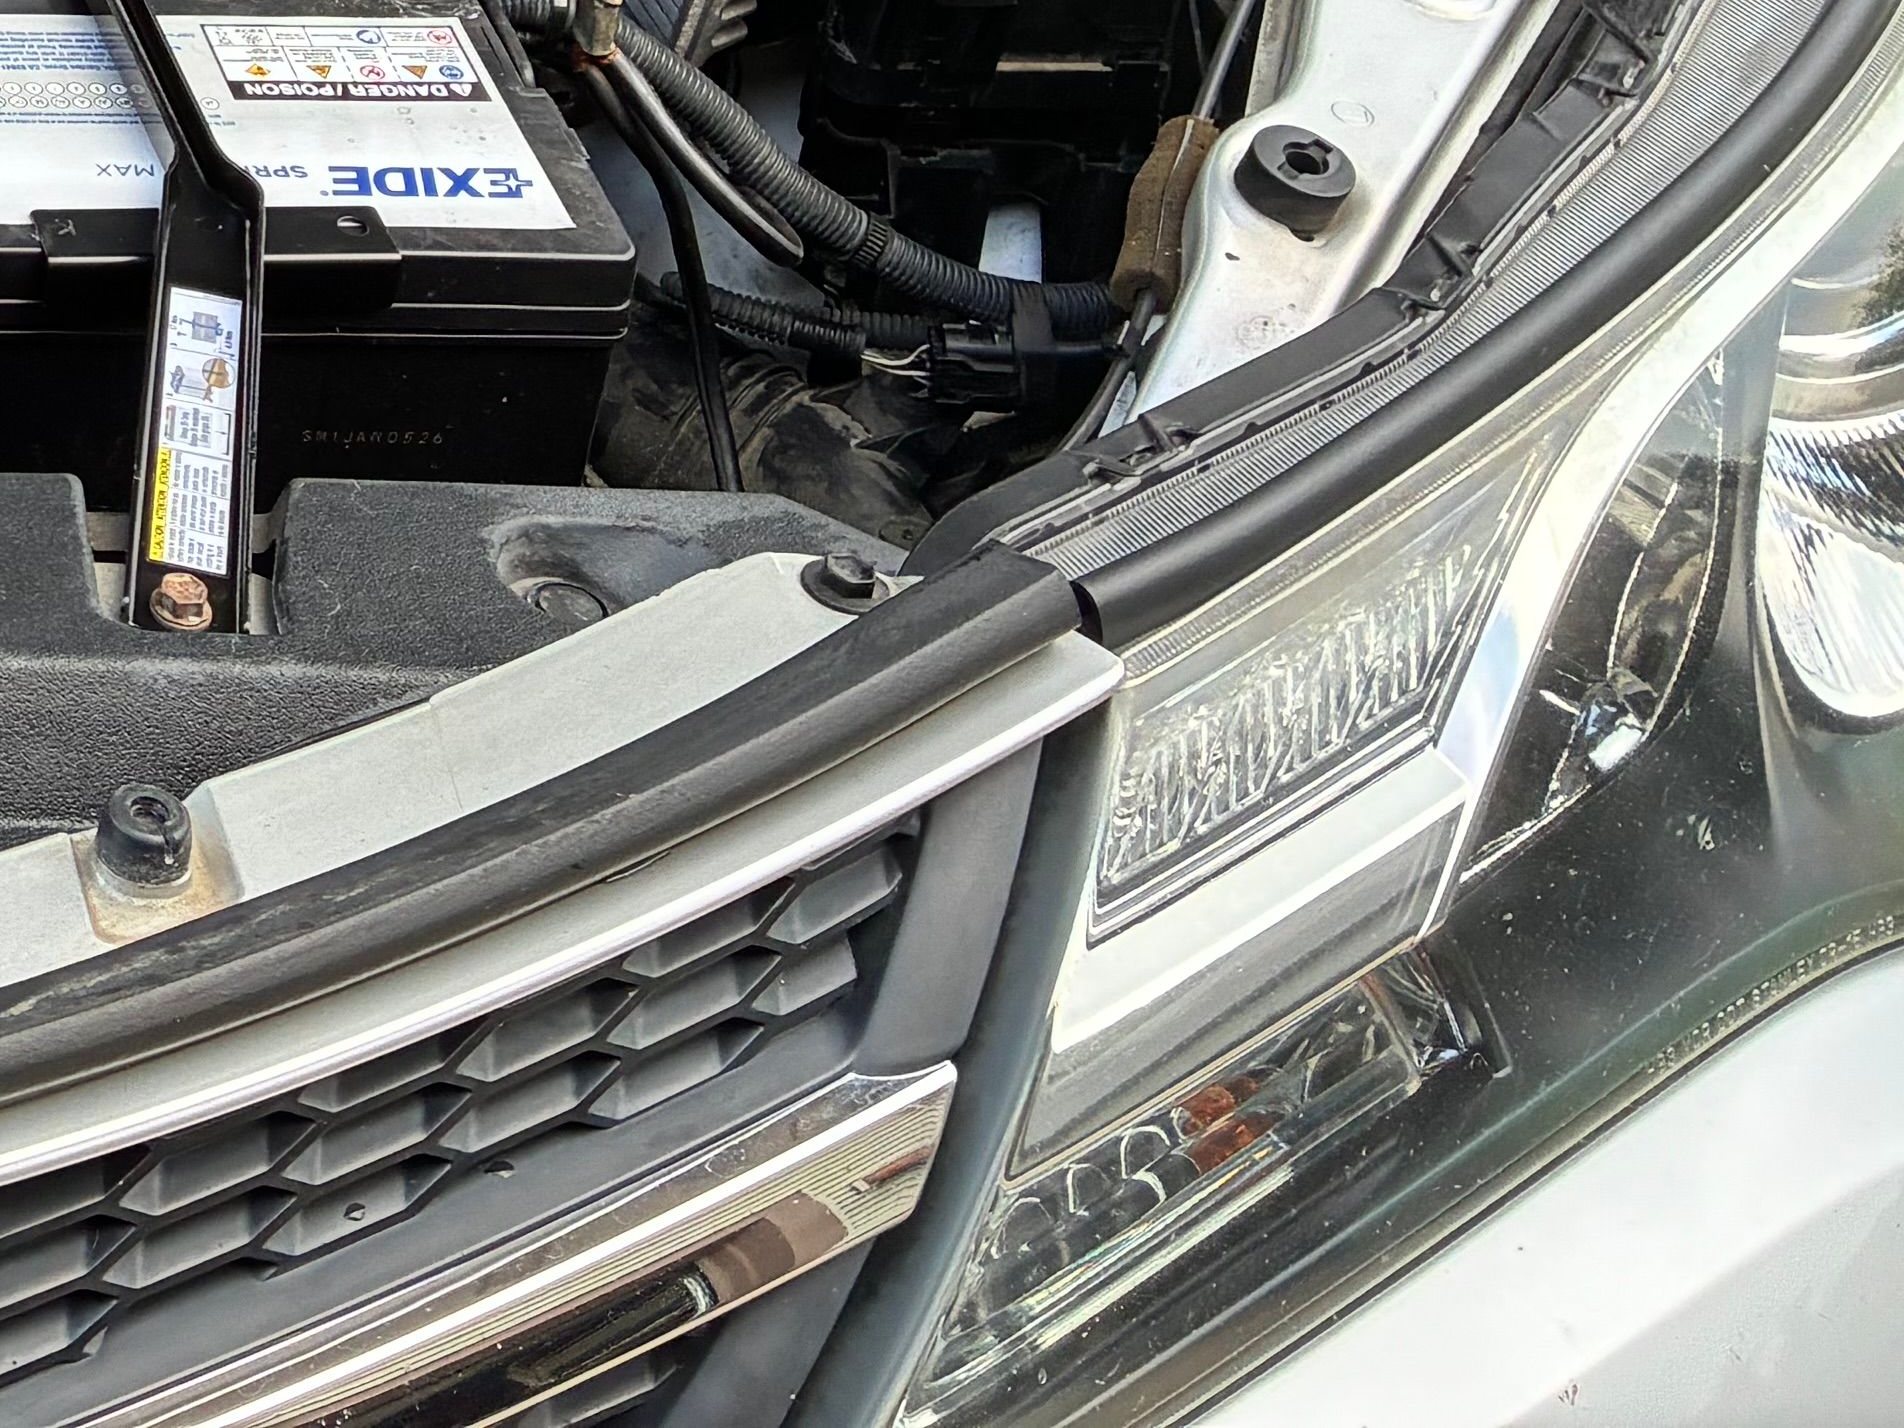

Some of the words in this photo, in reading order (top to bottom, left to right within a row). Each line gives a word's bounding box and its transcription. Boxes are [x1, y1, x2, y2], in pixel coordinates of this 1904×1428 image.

[246, 82, 335, 97] POISON
[350, 82, 450, 97] DANGER
[95, 163, 155, 177] MAX
[246, 164, 309, 179] SPR
[329, 165, 533, 198] EXIDE
